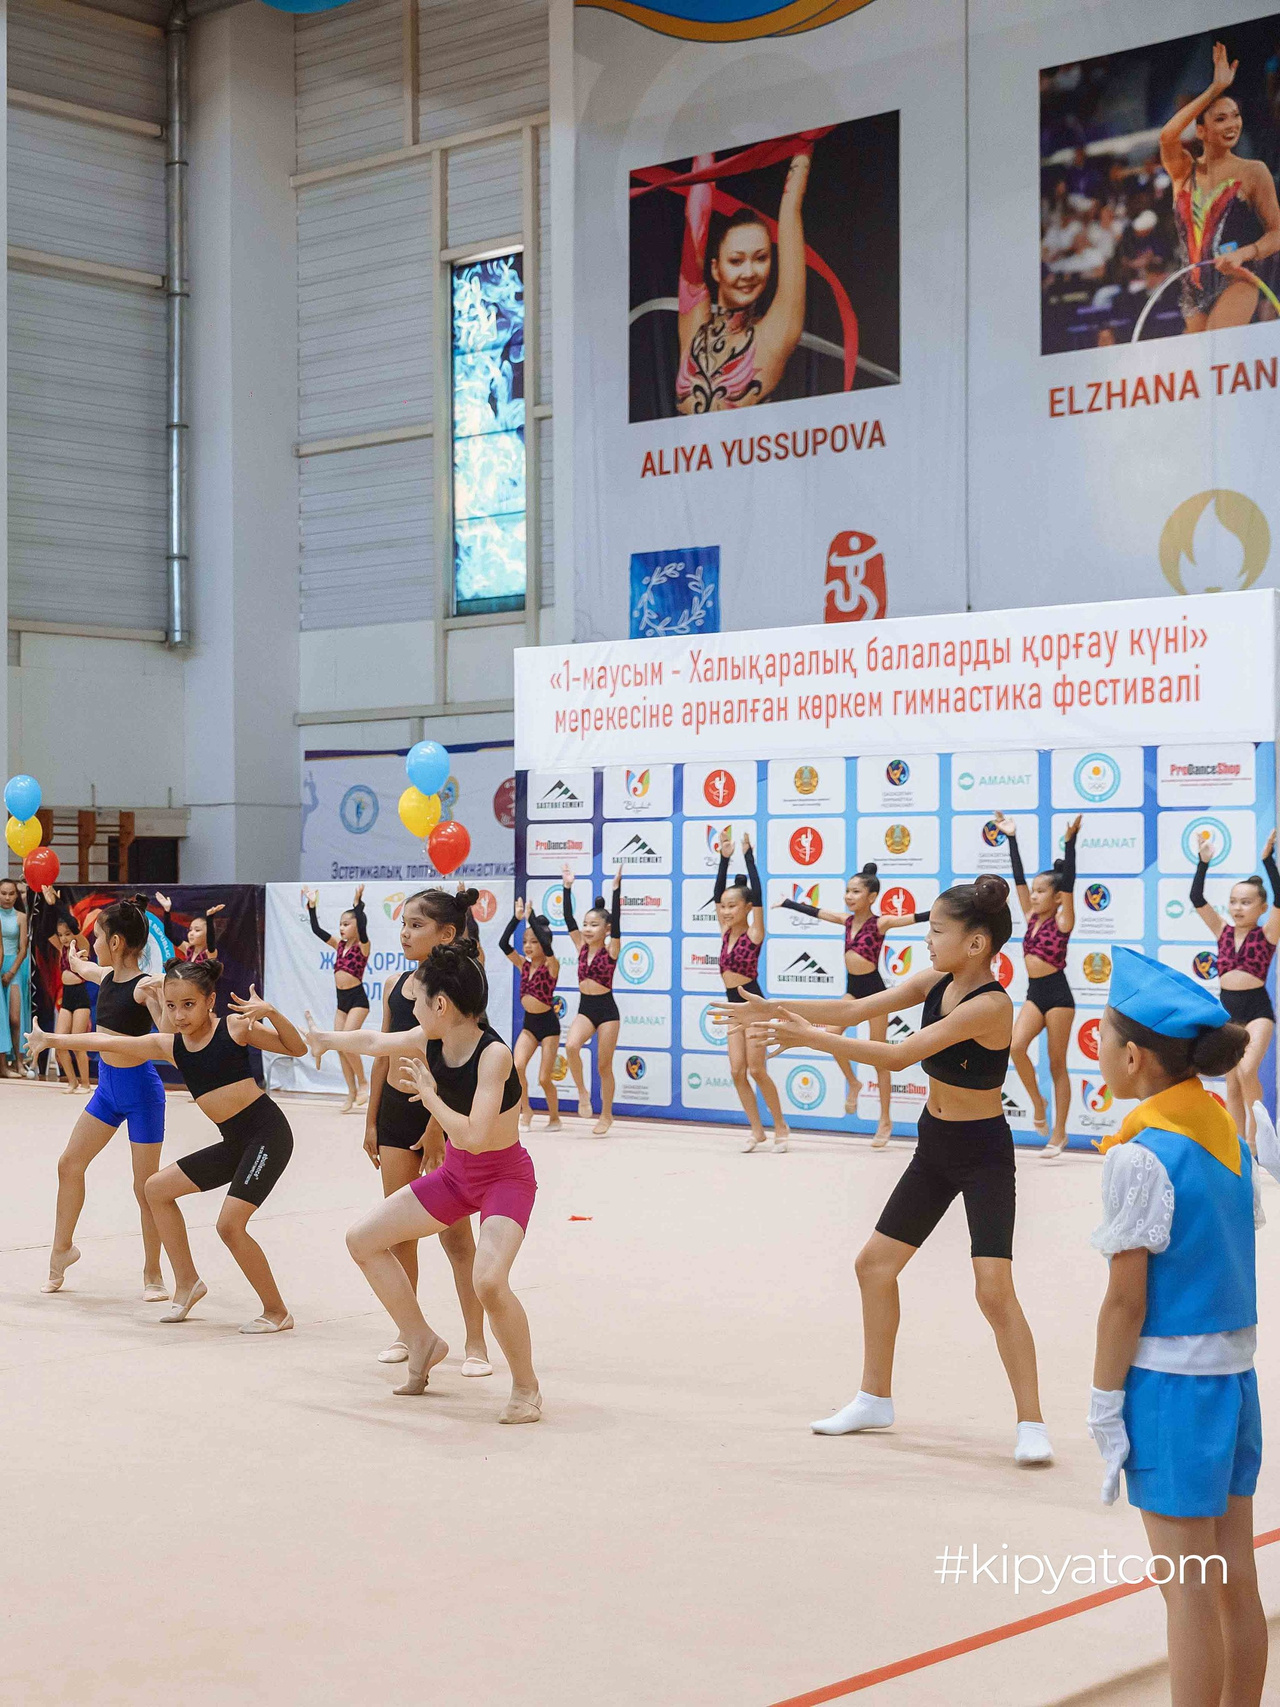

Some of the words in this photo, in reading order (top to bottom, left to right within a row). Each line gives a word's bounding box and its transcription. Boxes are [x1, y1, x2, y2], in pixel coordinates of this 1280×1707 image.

[1049, 370, 1199, 418] ELZHANA
[1210, 357, 1278, 395] TAN
[641, 444, 713, 478] ALIYA
[721, 420, 886, 467] YUSSUPOVA
[689, 648, 857, 684] Халықаралық
[867, 637, 1010, 676] балаларды
[1023, 628, 1118, 670] қорғау
[555, 696, 673, 740] мерекесіне
[682, 696, 788, 735] арналған
[798, 690, 882, 729] көркем
[893, 682, 1041, 716] гимнастика
[1053, 664, 1200, 716] фестивалі
[979, 774, 1032, 786] AMANAT
[1081, 838, 1137, 848] AMANAT
[624, 1016, 666, 1025] AMANAT
